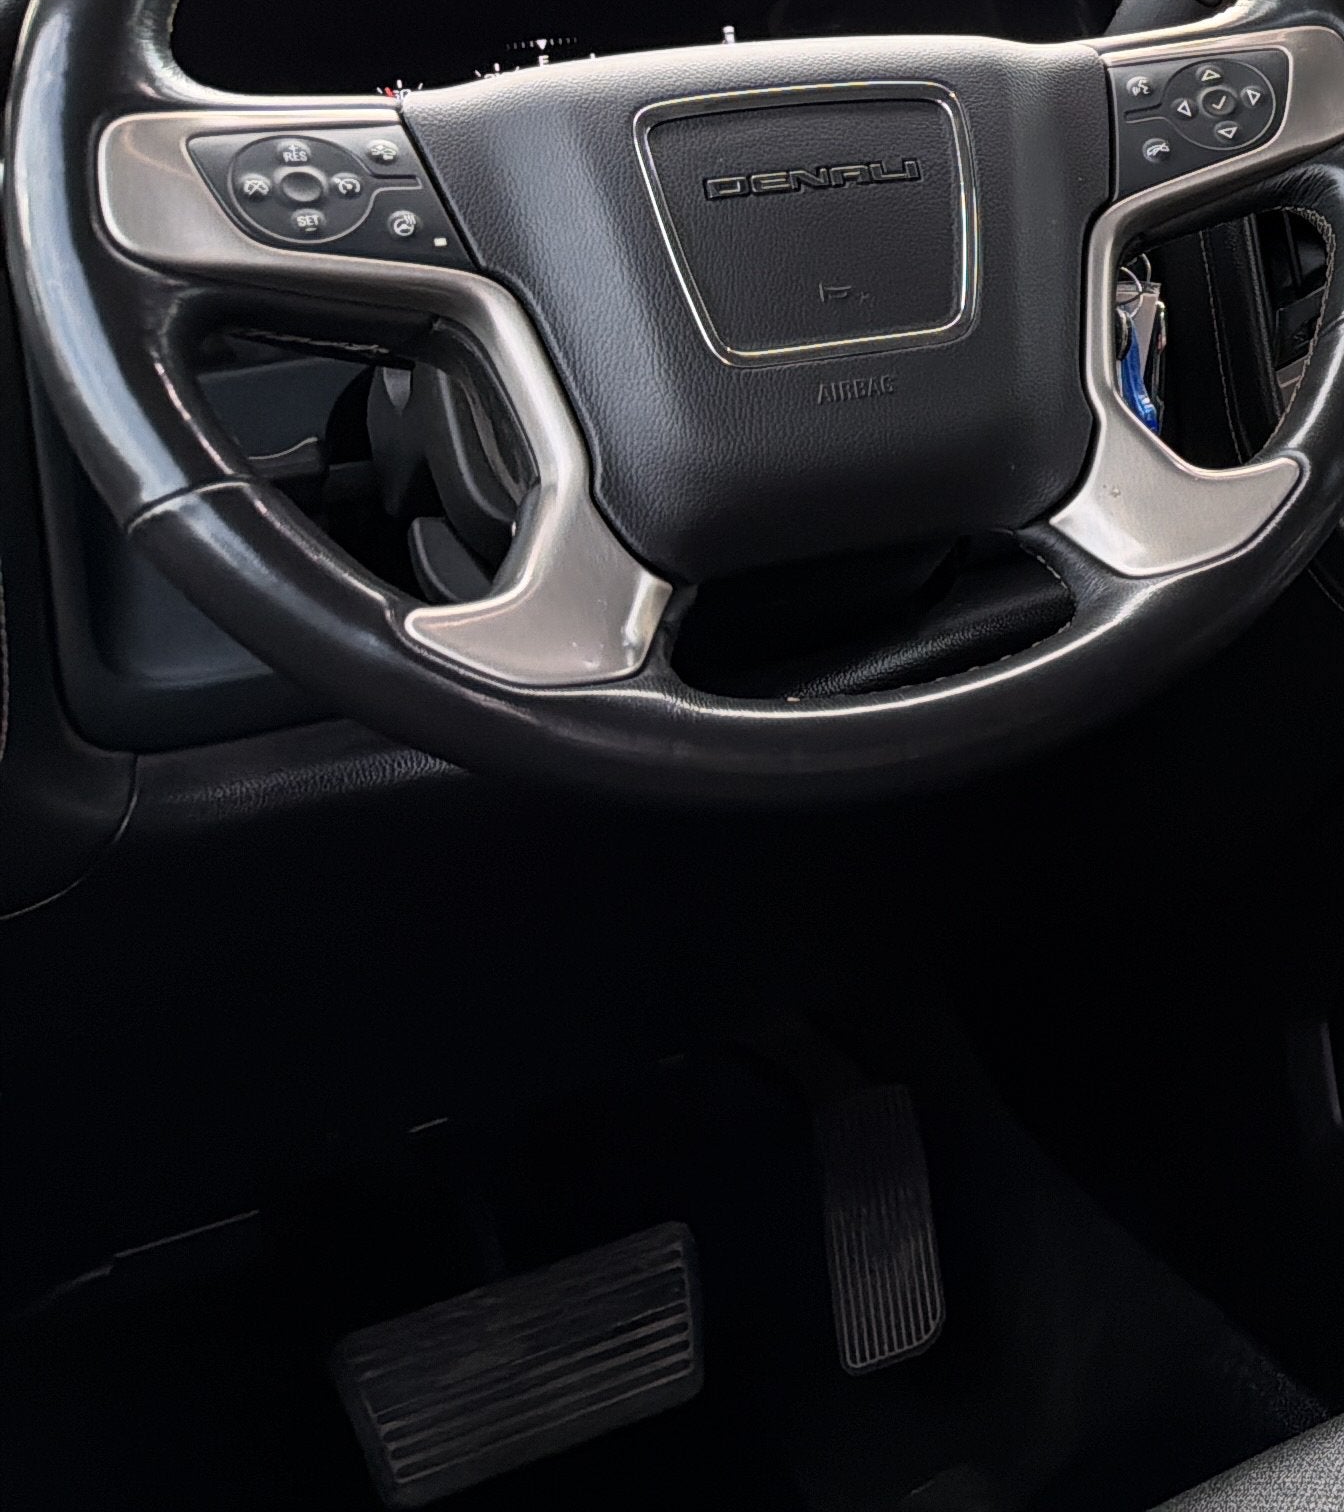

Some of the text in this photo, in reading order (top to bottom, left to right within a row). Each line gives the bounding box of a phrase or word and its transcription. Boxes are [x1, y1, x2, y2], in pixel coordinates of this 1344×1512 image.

[282, 150, 308, 163] RES
[703, 157, 922, 201] DENALI
[296, 215, 320, 227] SET
[816, 373, 896, 405] AIRBAG
